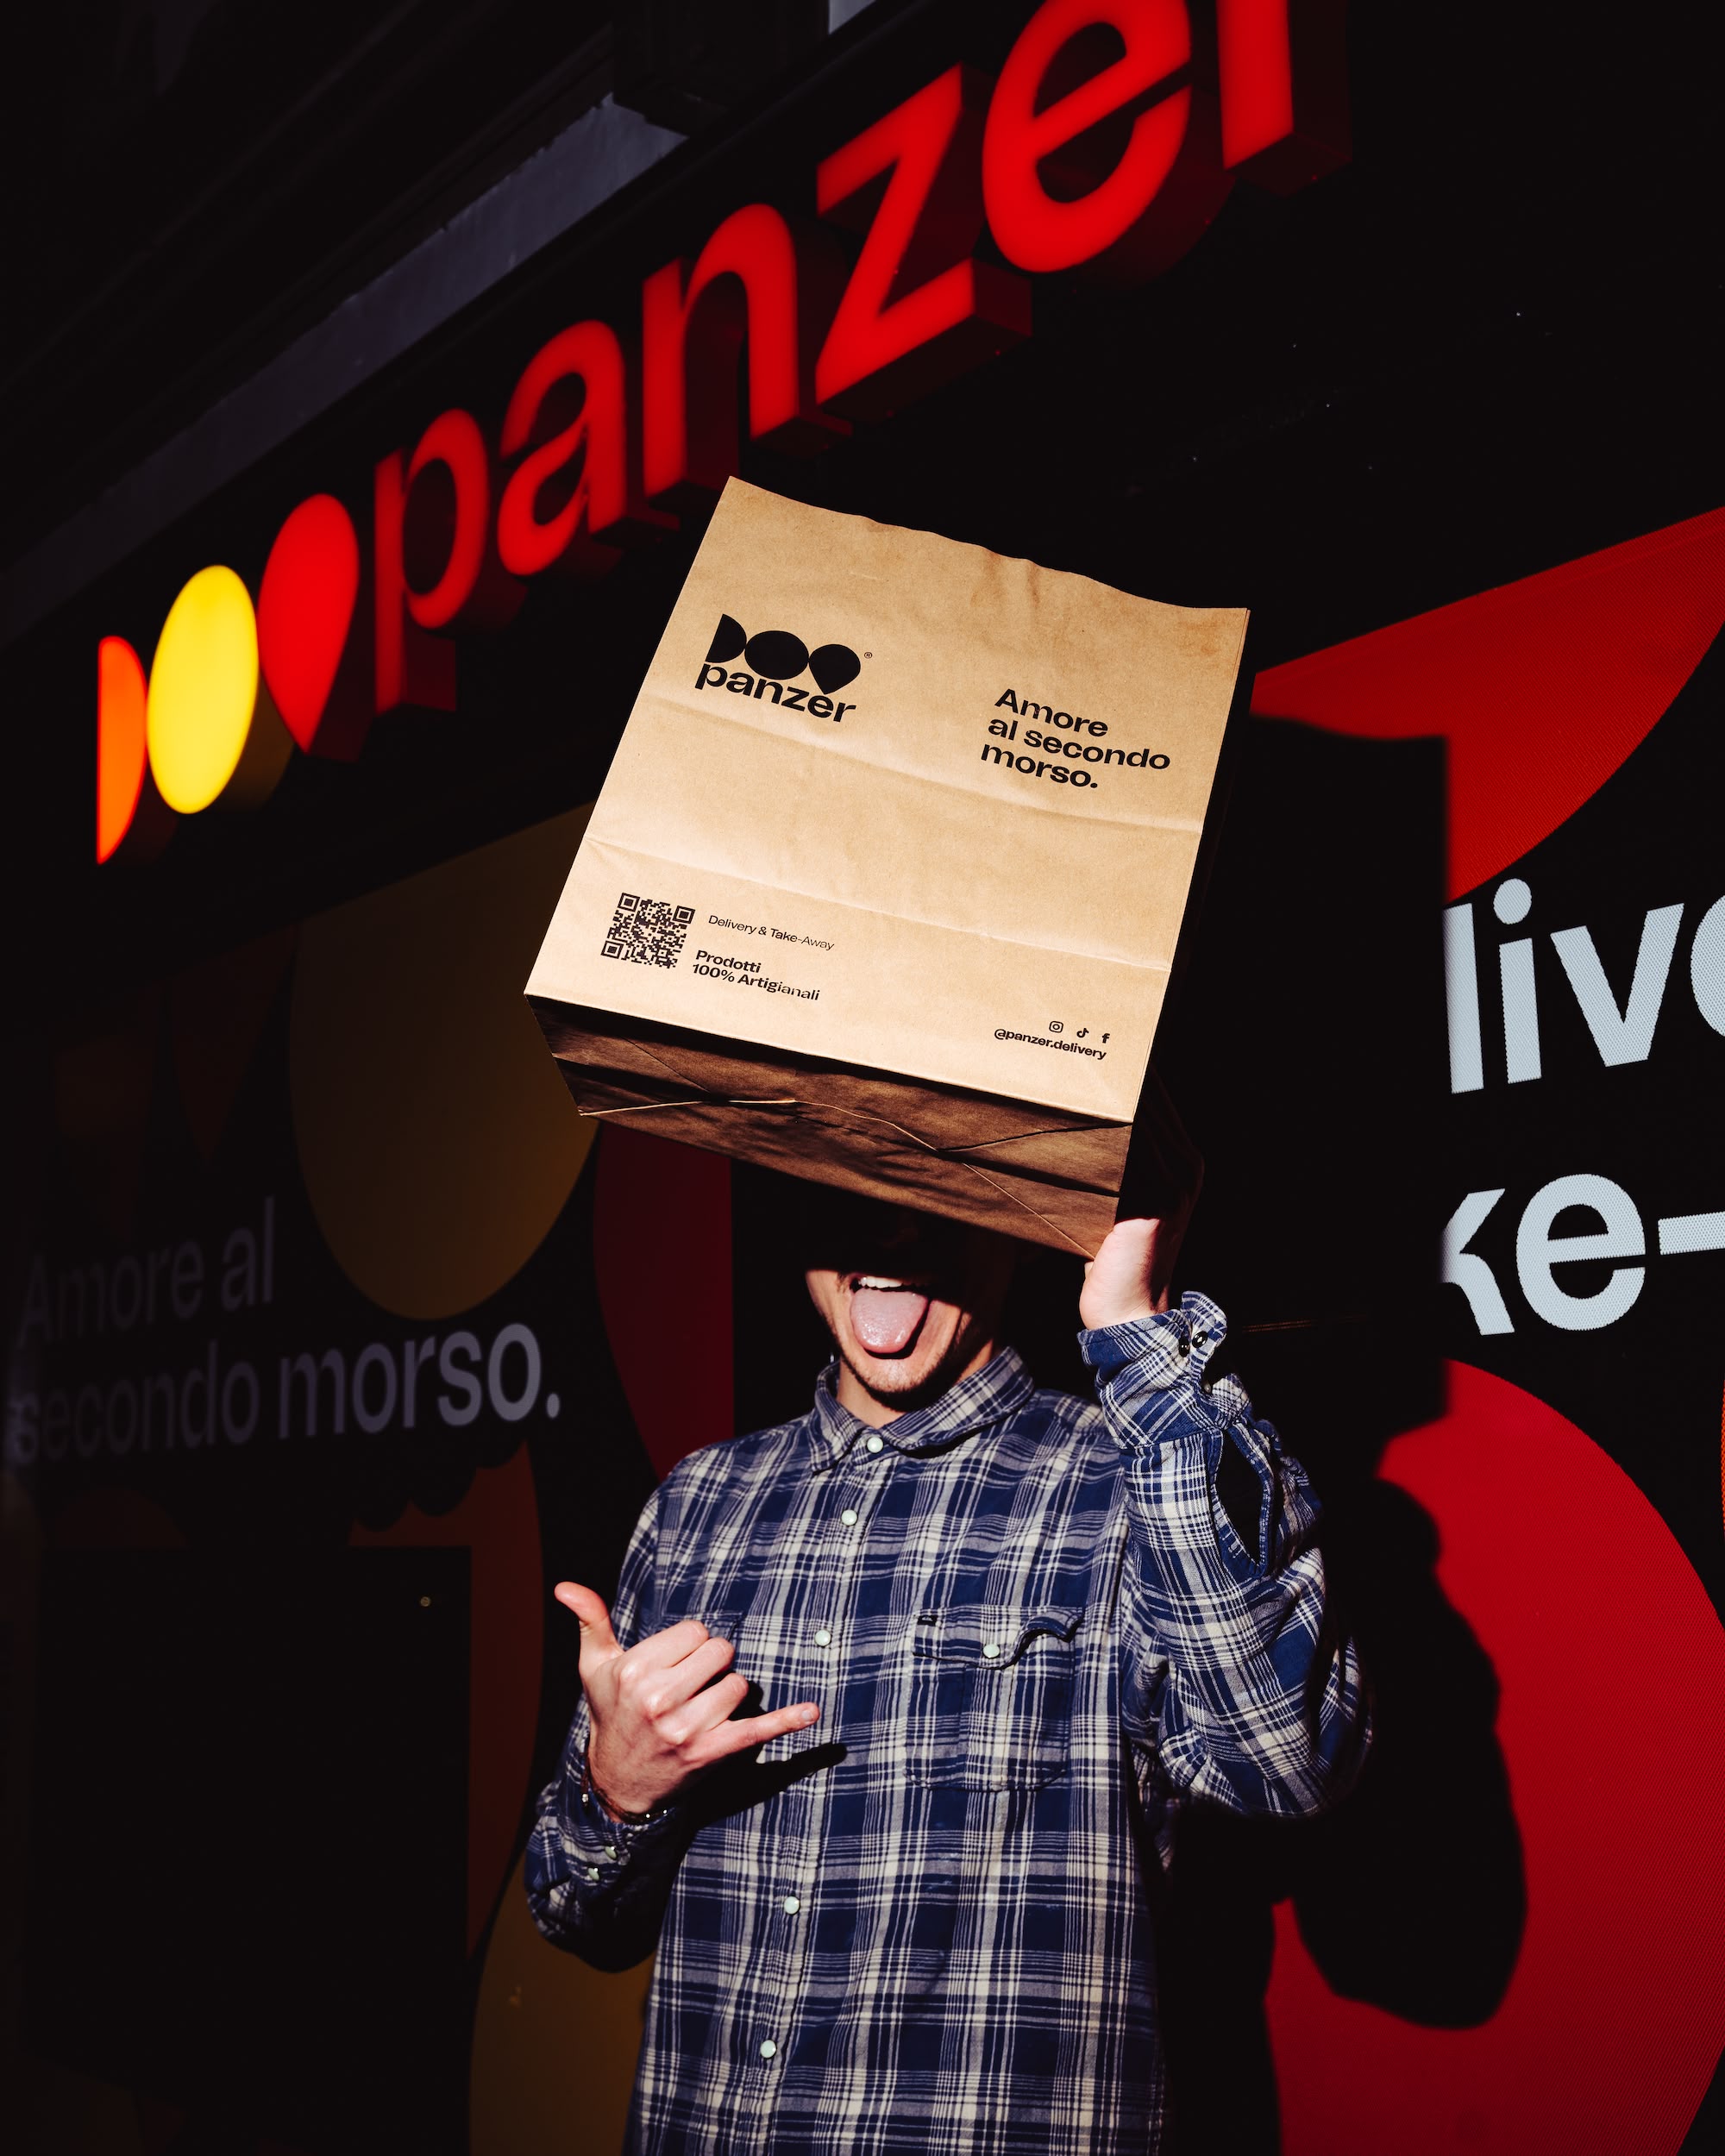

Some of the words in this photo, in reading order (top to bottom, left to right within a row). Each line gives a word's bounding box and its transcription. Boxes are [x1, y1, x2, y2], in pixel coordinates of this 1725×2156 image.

[694, 663, 857, 723] panzer
[994, 688, 1109, 737] Amore
[981, 743, 1098, 789] morso.
[988, 718, 1019, 741] al
[1023, 730, 1171, 770] secondo
[707, 914, 757, 935] Delivery
[757, 925, 768, 936] &
[769, 927, 835, 951] Take-Away
[692, 963, 735, 982] 100%
[737, 974, 820, 1000] Artigianali
[695, 950, 762, 974] Prodotti
[1442, 878, 1725, 1094] liv
[994, 1028, 1107, 1061] @panzer.delivery
[16, 1251, 205, 1349] Amore
[220, 1194, 275, 1313] al
[5, 1338, 260, 1465] secondo
[278, 1322, 561, 1439] morso.
